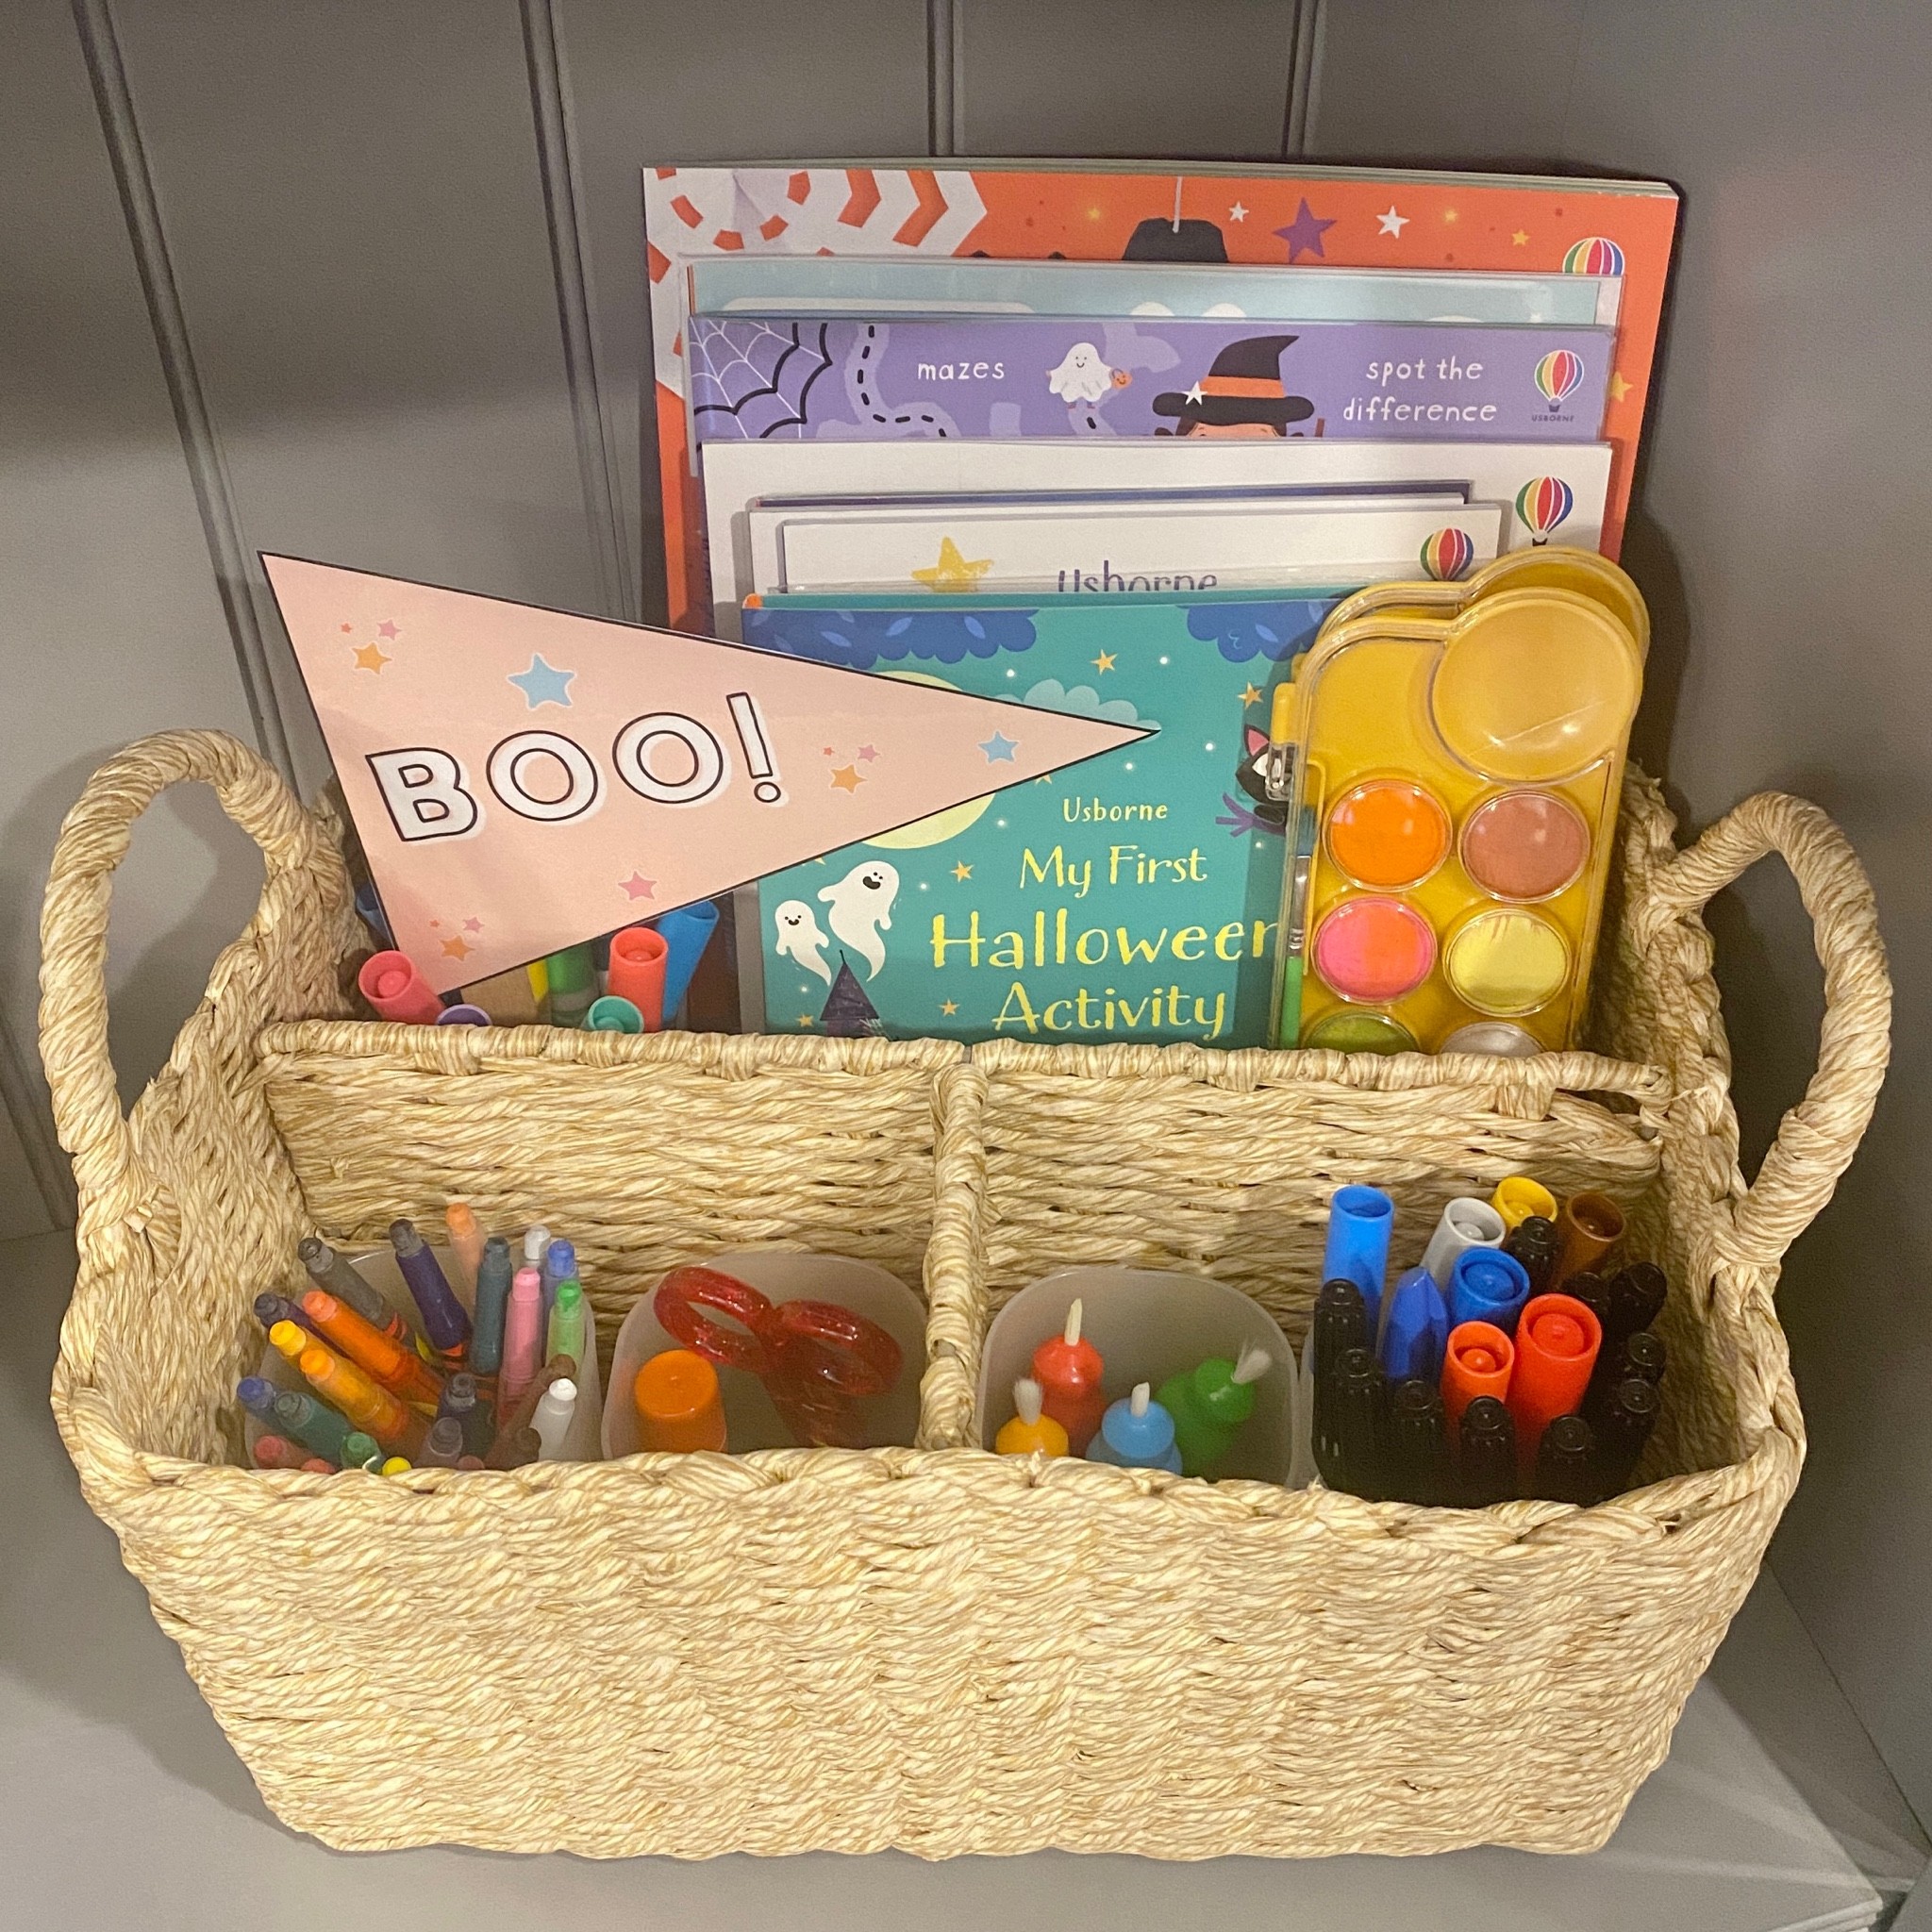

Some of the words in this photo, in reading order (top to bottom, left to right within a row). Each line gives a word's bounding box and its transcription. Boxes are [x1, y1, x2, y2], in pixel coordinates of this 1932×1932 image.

[918, 361, 1005, 380] mazes
[1366, 358, 1425, 387] spot
[1436, 356, 1484, 380] the
[1343, 396, 1497, 422] difference
[365, 691, 784, 842] BOO!
[1062, 797, 1169, 823] Usborne
[1020, 846, 1092, 898] My
[1109, 845, 1208, 885] First
[991, 980, 1227, 1039] Activity
